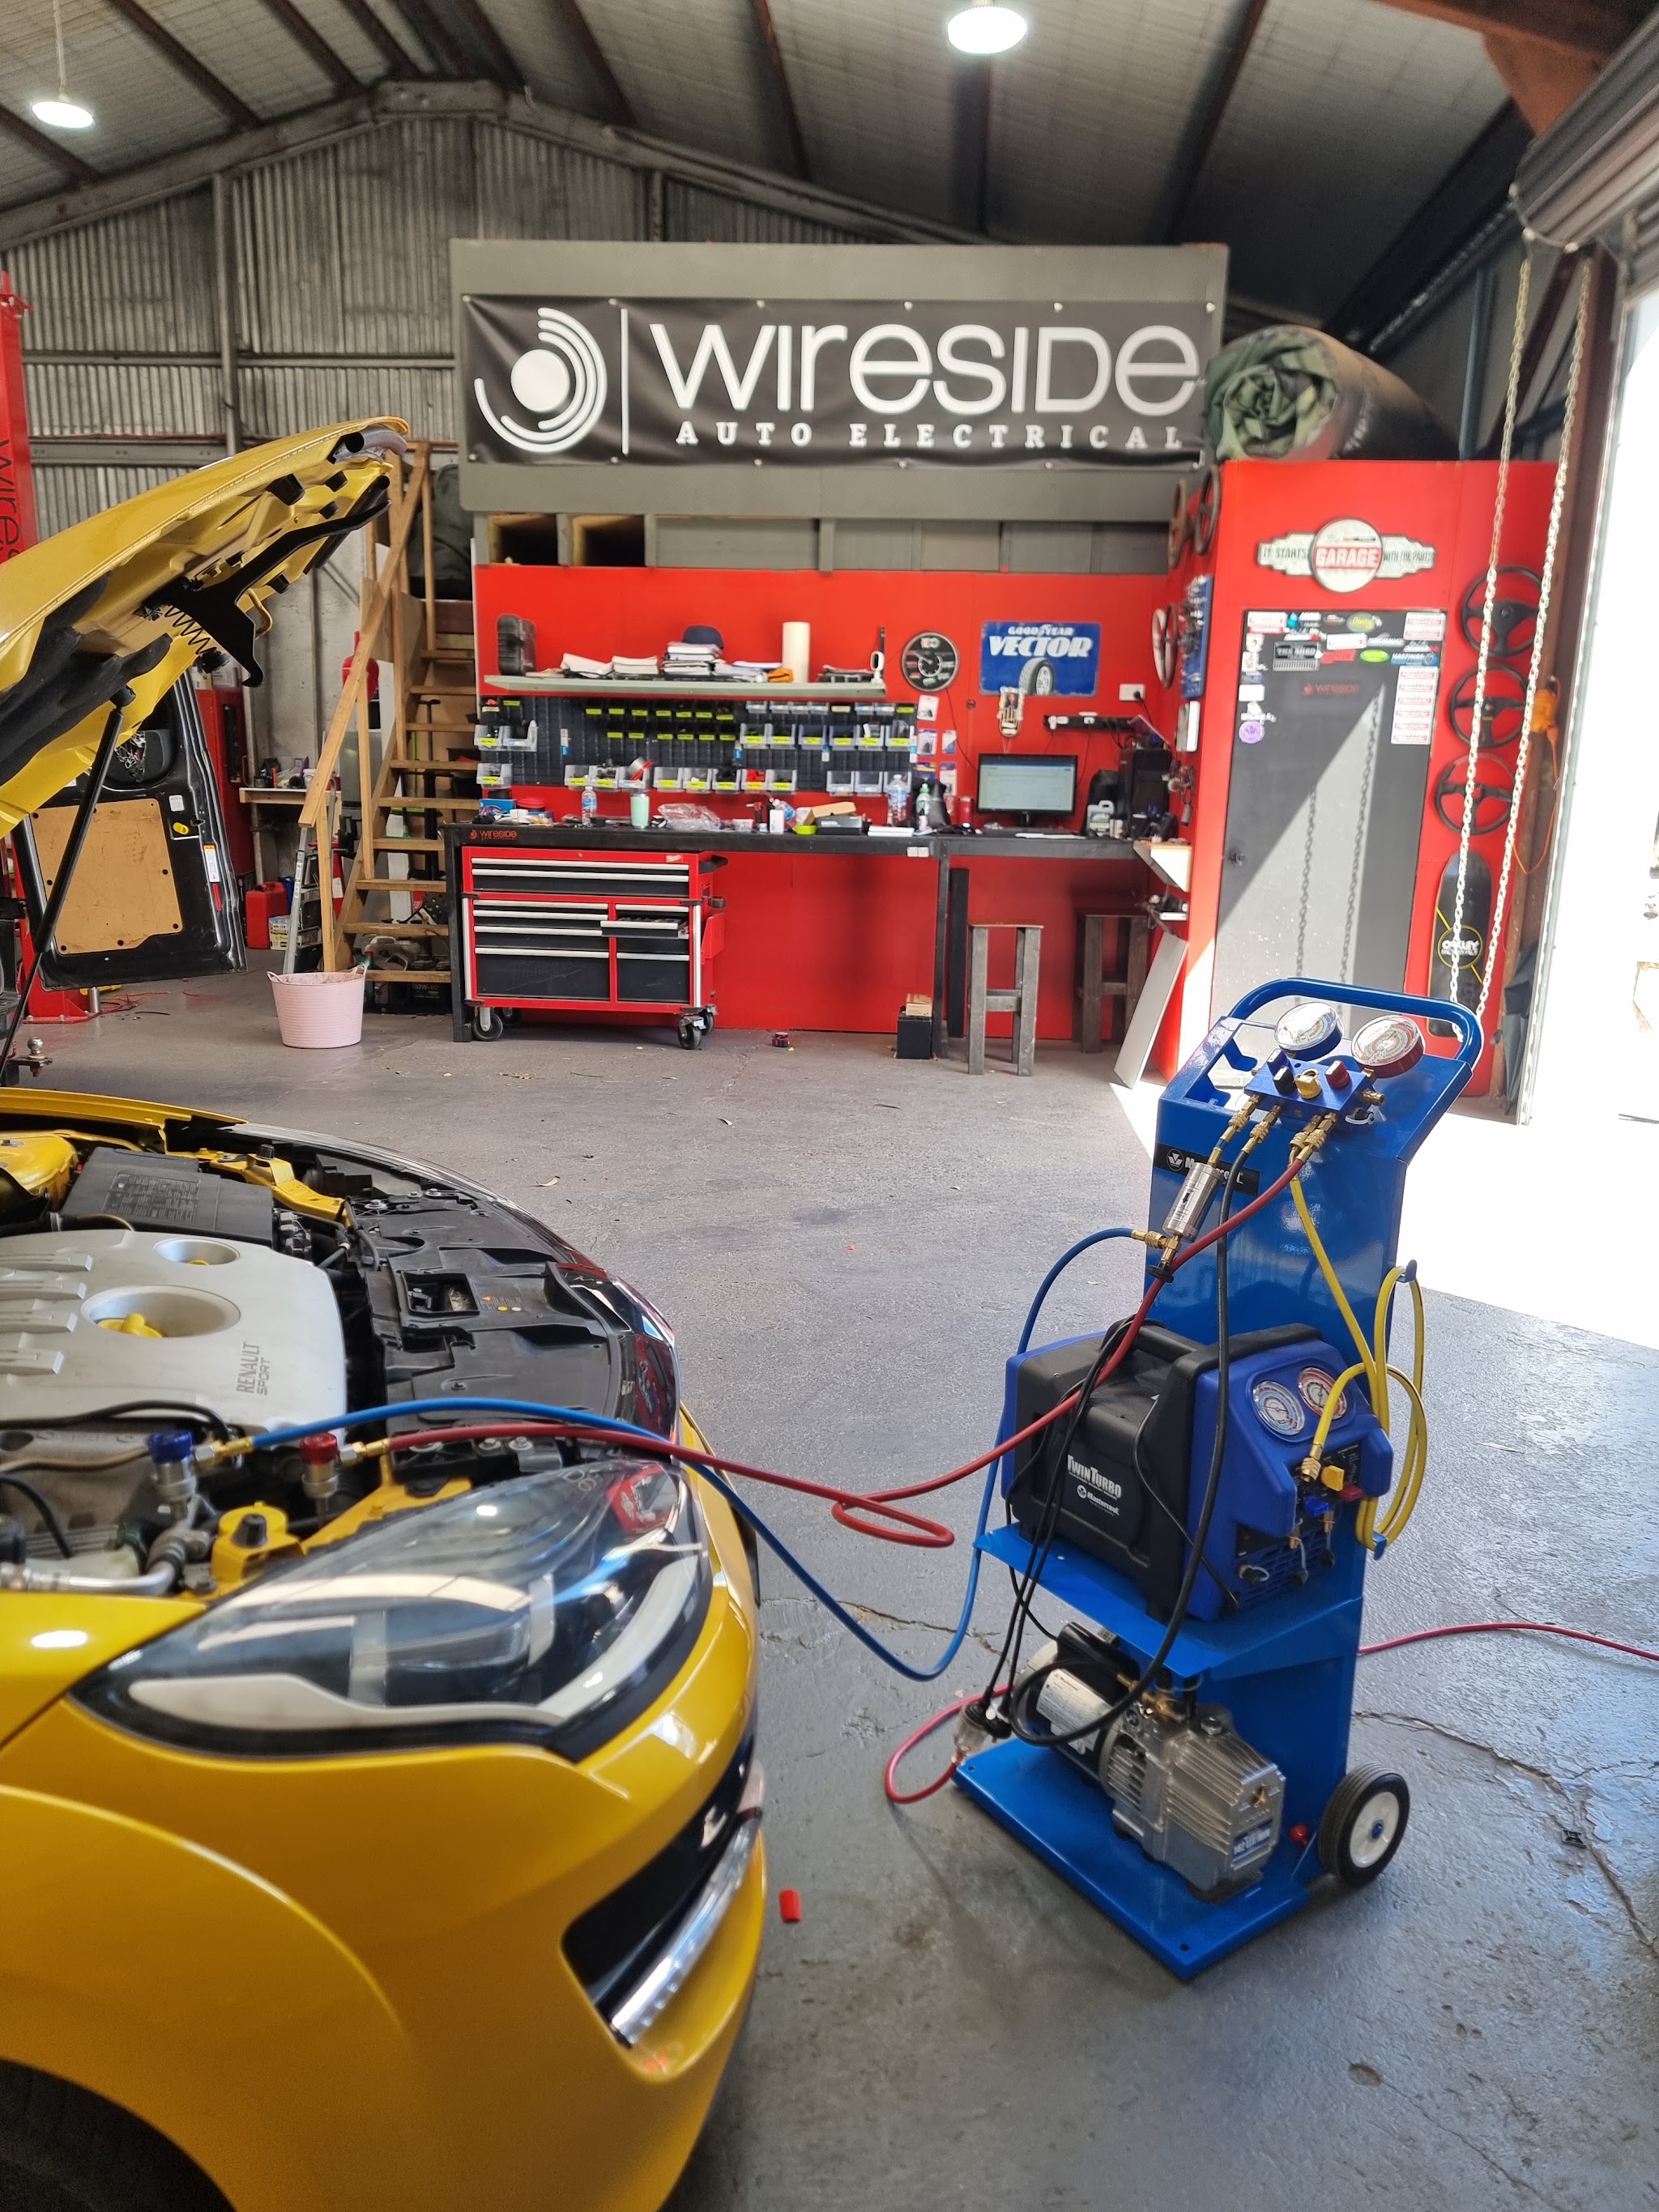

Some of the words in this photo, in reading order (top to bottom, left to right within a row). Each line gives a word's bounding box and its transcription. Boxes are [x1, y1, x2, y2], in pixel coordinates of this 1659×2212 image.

[676, 420, 813, 446] AUTO
[848, 422, 1185, 450] ELECTRICAL
[1316, 547, 1380, 568] GARAGE
[989, 635, 1094, 658] VECTOR
[237, 1341, 259, 1393] RENAULT
[257, 1357, 271, 1396] SPORT
